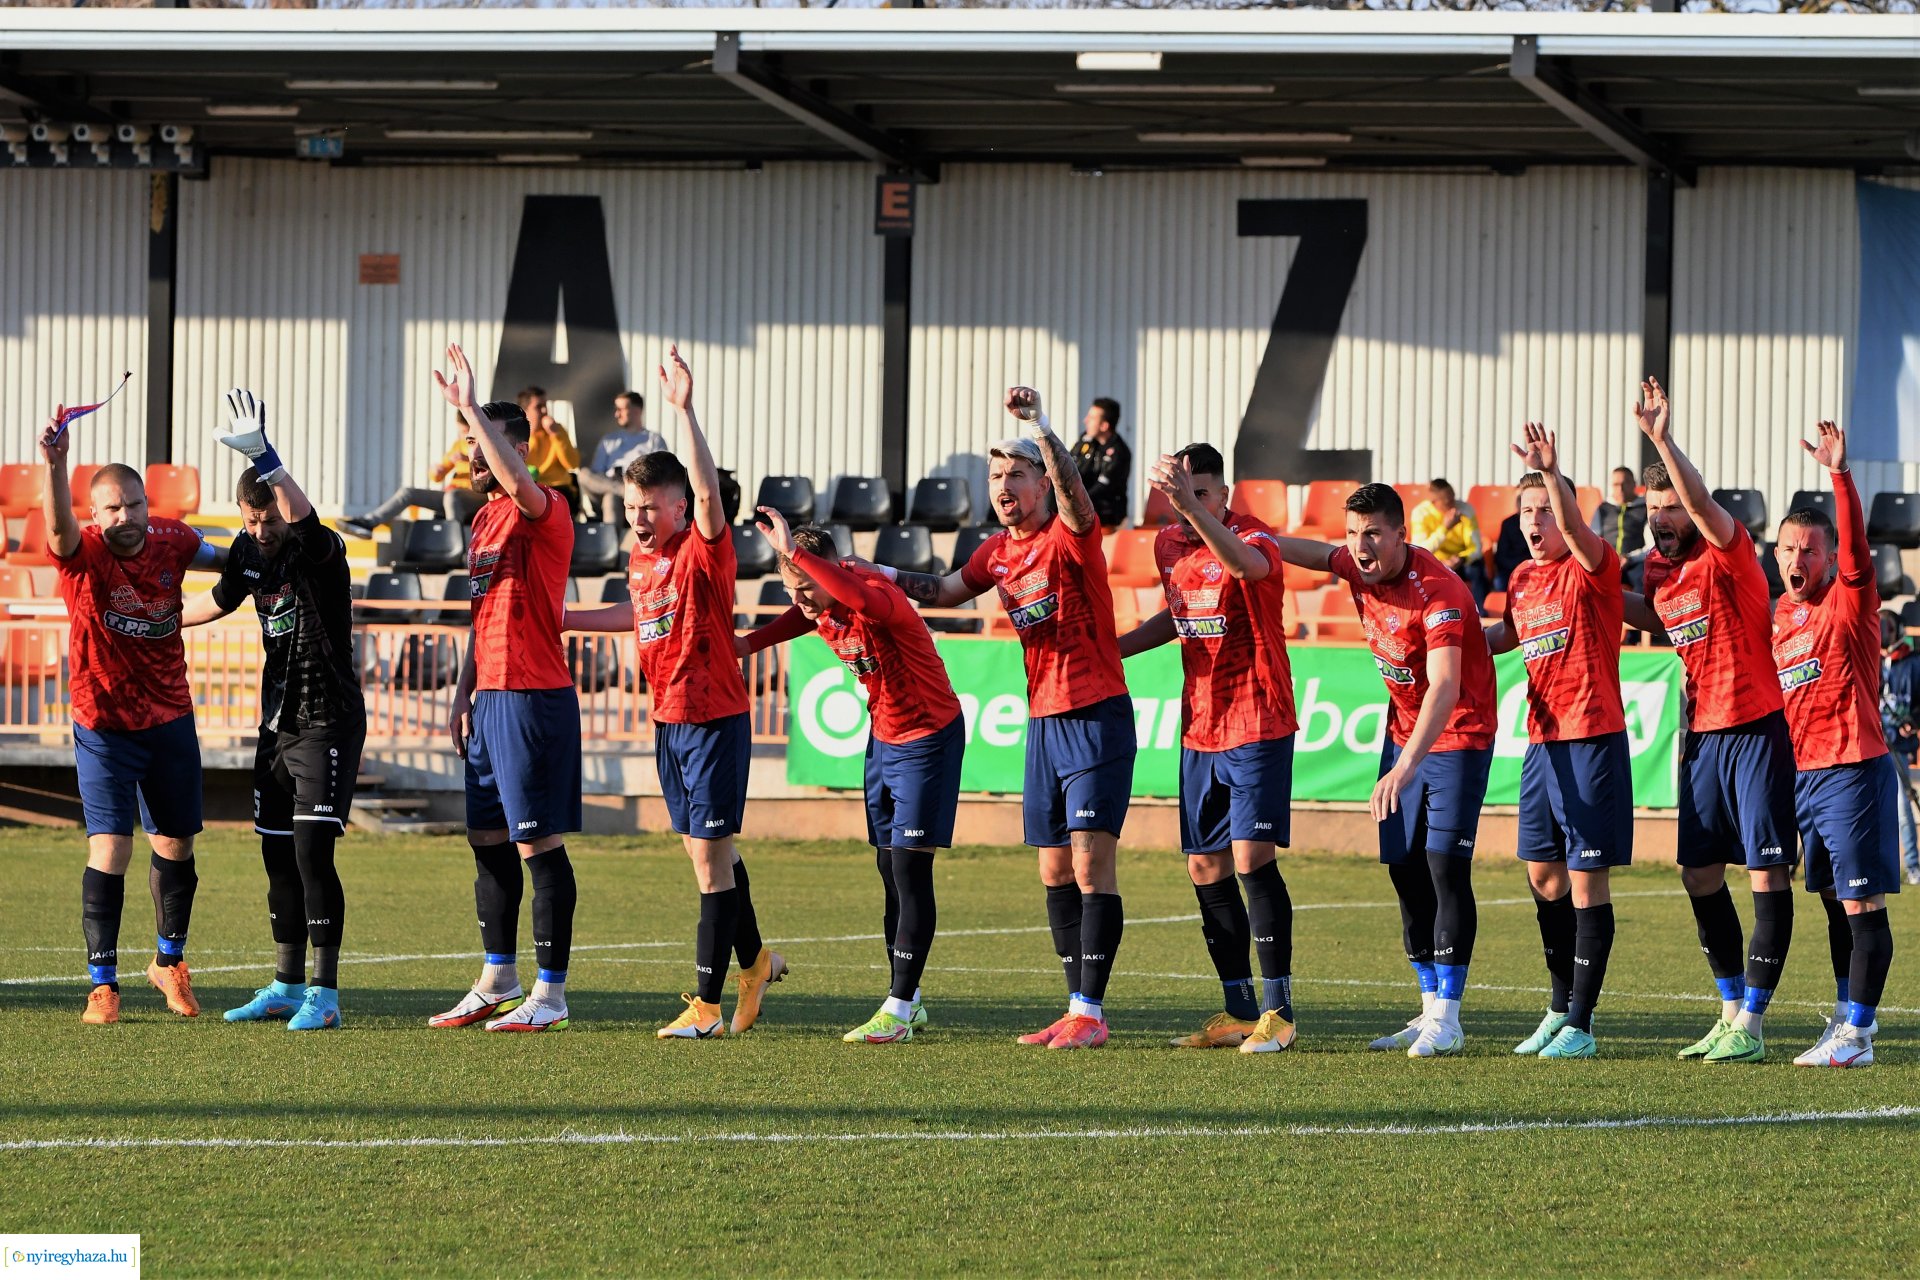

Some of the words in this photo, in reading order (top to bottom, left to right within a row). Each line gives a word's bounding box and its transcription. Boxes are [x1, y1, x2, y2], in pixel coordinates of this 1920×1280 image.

[881, 182, 911, 217] E
[489, 195, 627, 462] A
[1233, 199, 1373, 485] Z
[243, 568, 260, 579] JAKO
[313, 804, 334, 813] JAKO
[1075, 809, 1096, 818] JAKO
[518, 821, 538, 830] JAKO
[705, 819, 725, 828] JAKO
[1254, 821, 1273, 830] JAKO
[904, 829, 925, 837] JAKO
[1458, 838, 1474, 848] JAKO
[1580, 850, 1602, 858] JAKO
[1761, 847, 1782, 856] JAKO
[1848, 877, 1869, 887] JAKO
[90, 949, 115, 960] JAKO
[1082, 953, 1105, 961] JAKO
[1749, 955, 1779, 964] JAKO
